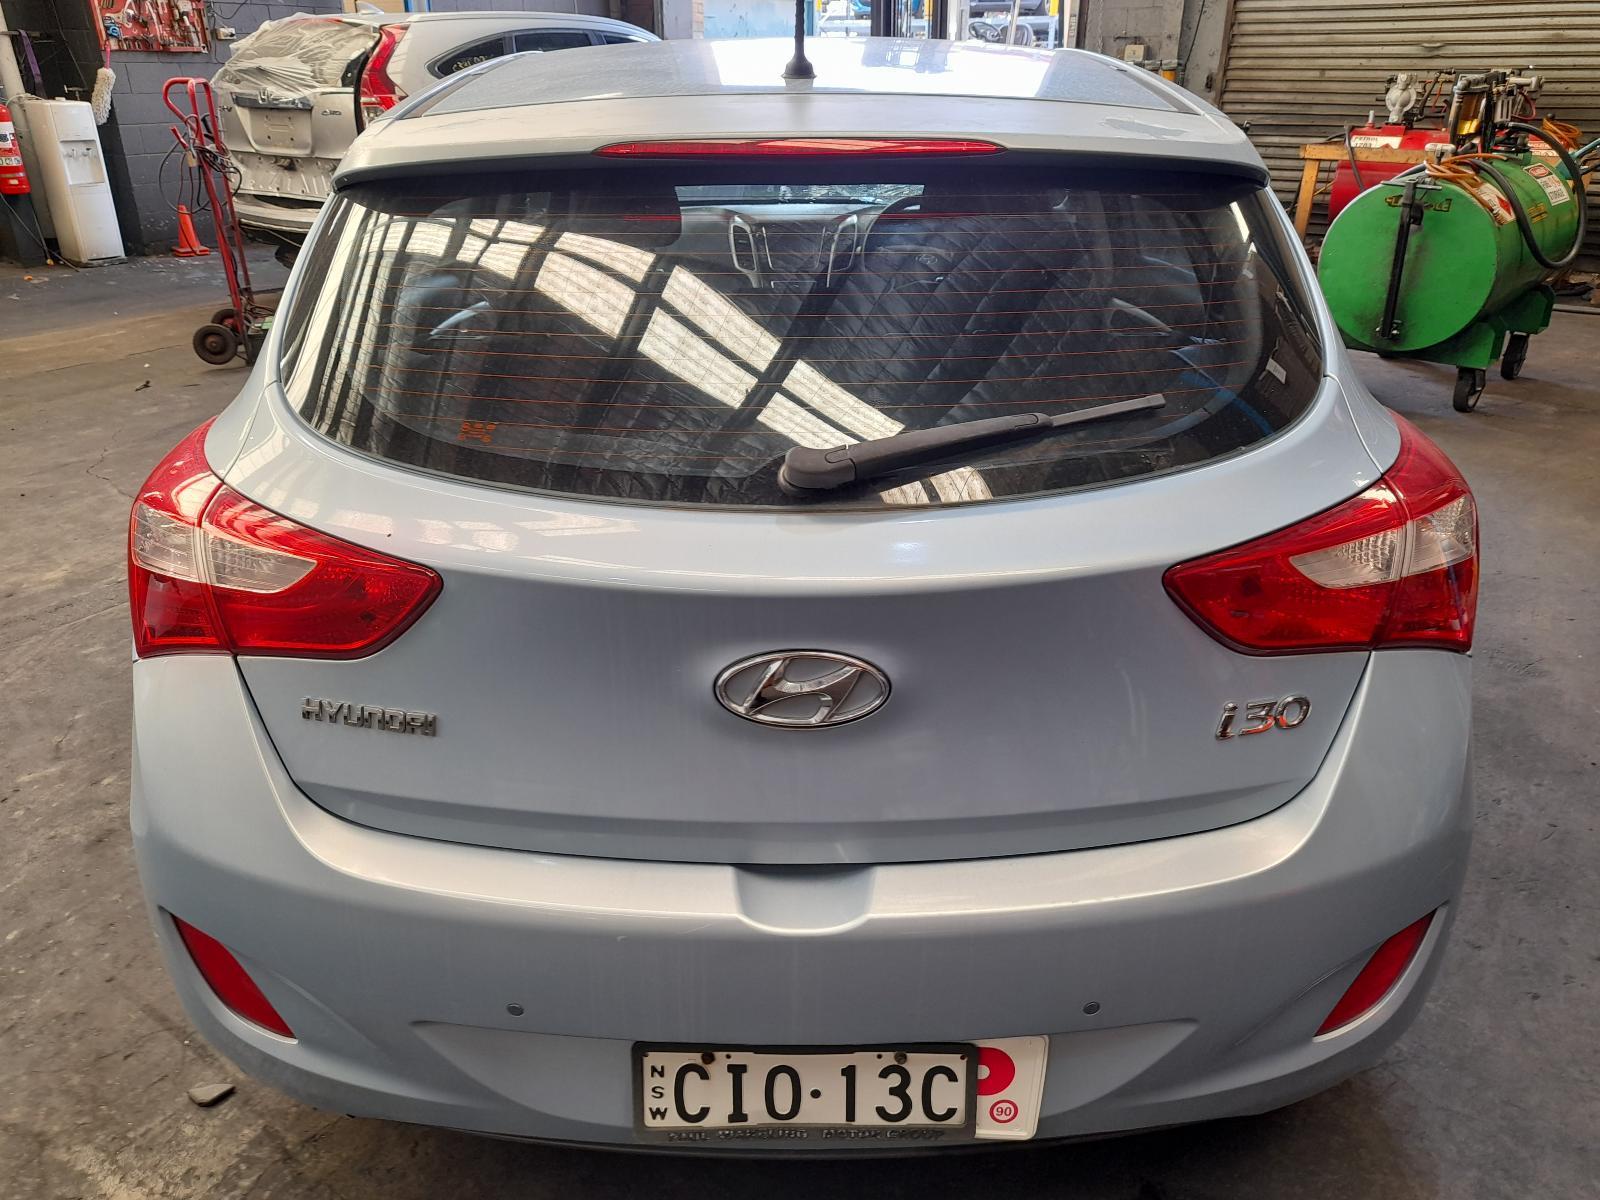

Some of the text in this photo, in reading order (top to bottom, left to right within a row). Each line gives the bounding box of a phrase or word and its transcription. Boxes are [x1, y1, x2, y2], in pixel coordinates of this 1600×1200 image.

[301, 696, 437, 737] HYUNDAI
[1216, 694, 1311, 741] i30
[995, 1106, 1012, 1117] 90
